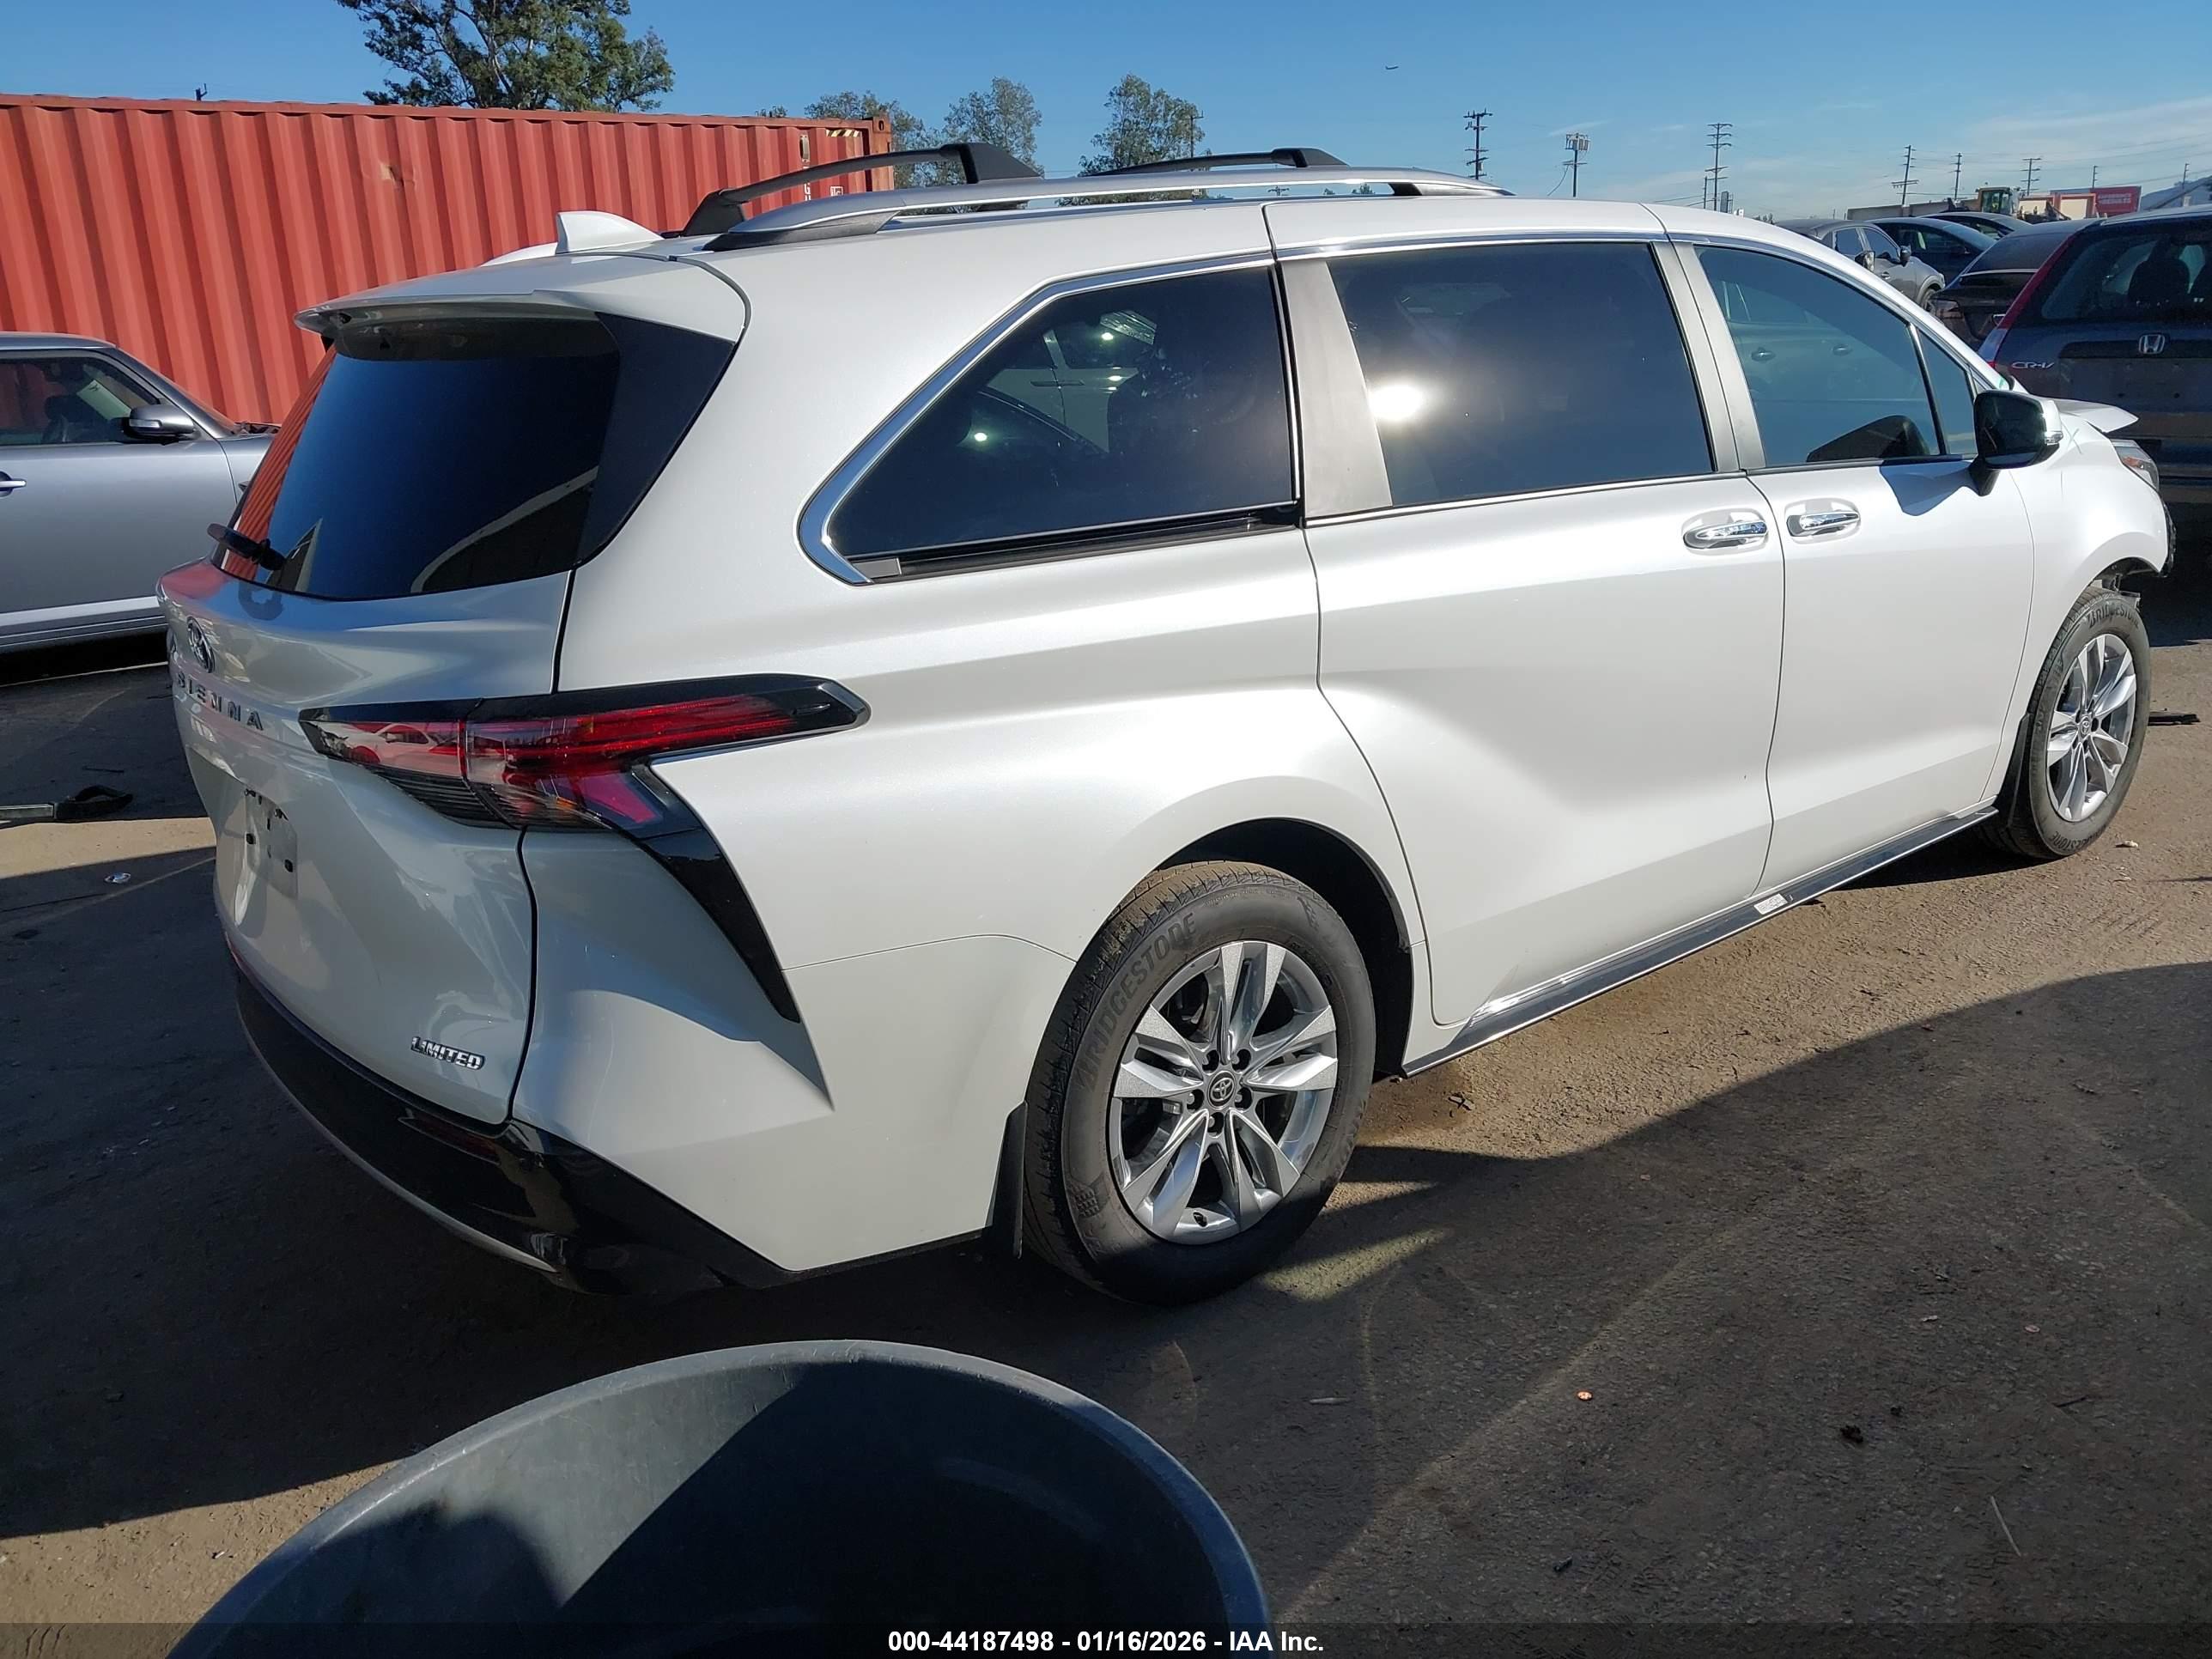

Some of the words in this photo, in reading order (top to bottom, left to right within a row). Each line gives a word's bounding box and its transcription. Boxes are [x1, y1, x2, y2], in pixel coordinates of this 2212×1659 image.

[2011, 361, 2055, 369] CR-V
[177, 671, 264, 732] SIENNA
[410, 1036, 486, 1071] LIMITED
